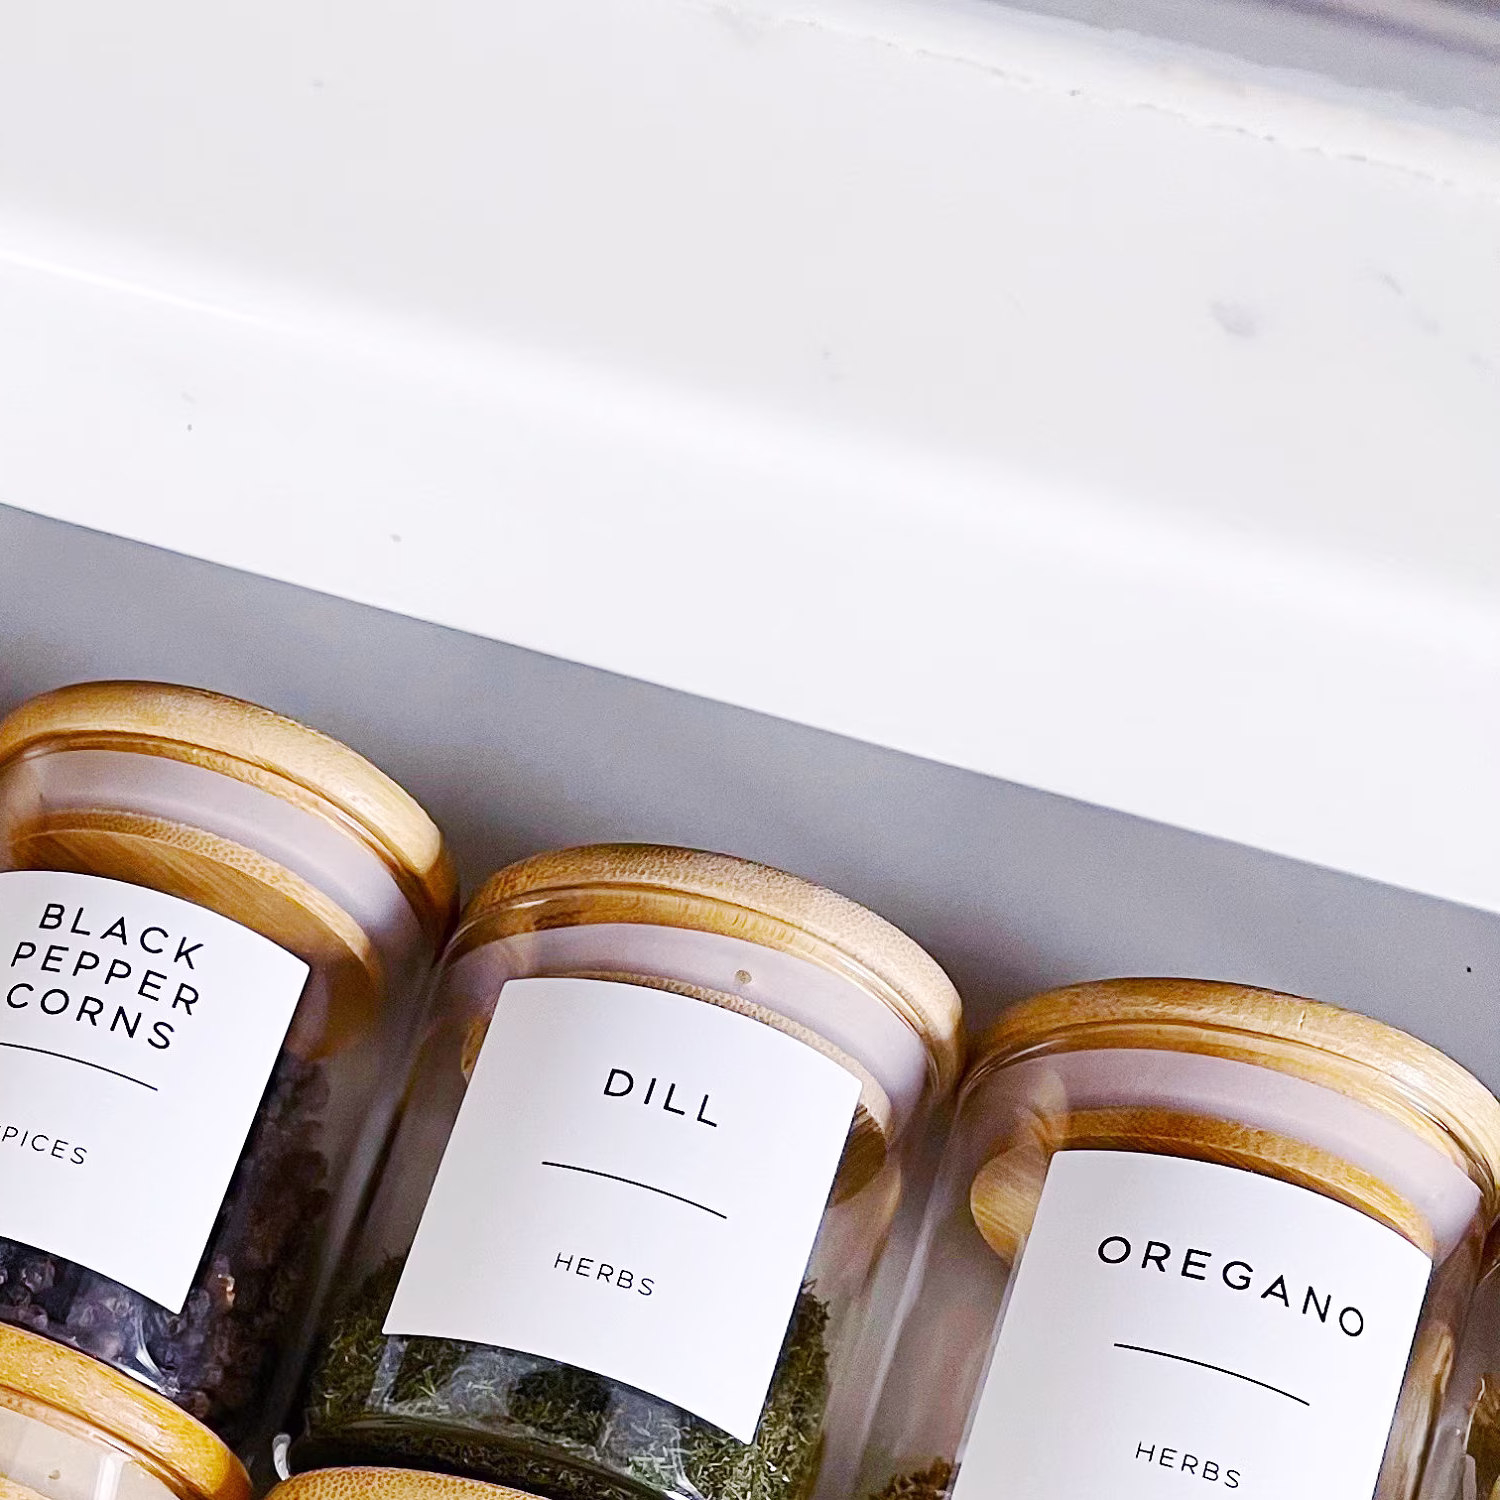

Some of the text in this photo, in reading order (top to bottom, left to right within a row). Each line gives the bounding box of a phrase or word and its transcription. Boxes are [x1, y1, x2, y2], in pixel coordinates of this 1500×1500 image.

[38, 902, 205, 971] BLACK
[10, 941, 200, 1016] PEPPER
[6, 982, 175, 1050] CORNS
[603, 1067, 718, 1128] DILL
[553, 1251, 655, 1297] HERBS
[1097, 1235, 1364, 1338] OREGANO
[1135, 1440, 1241, 1489] HERBS
